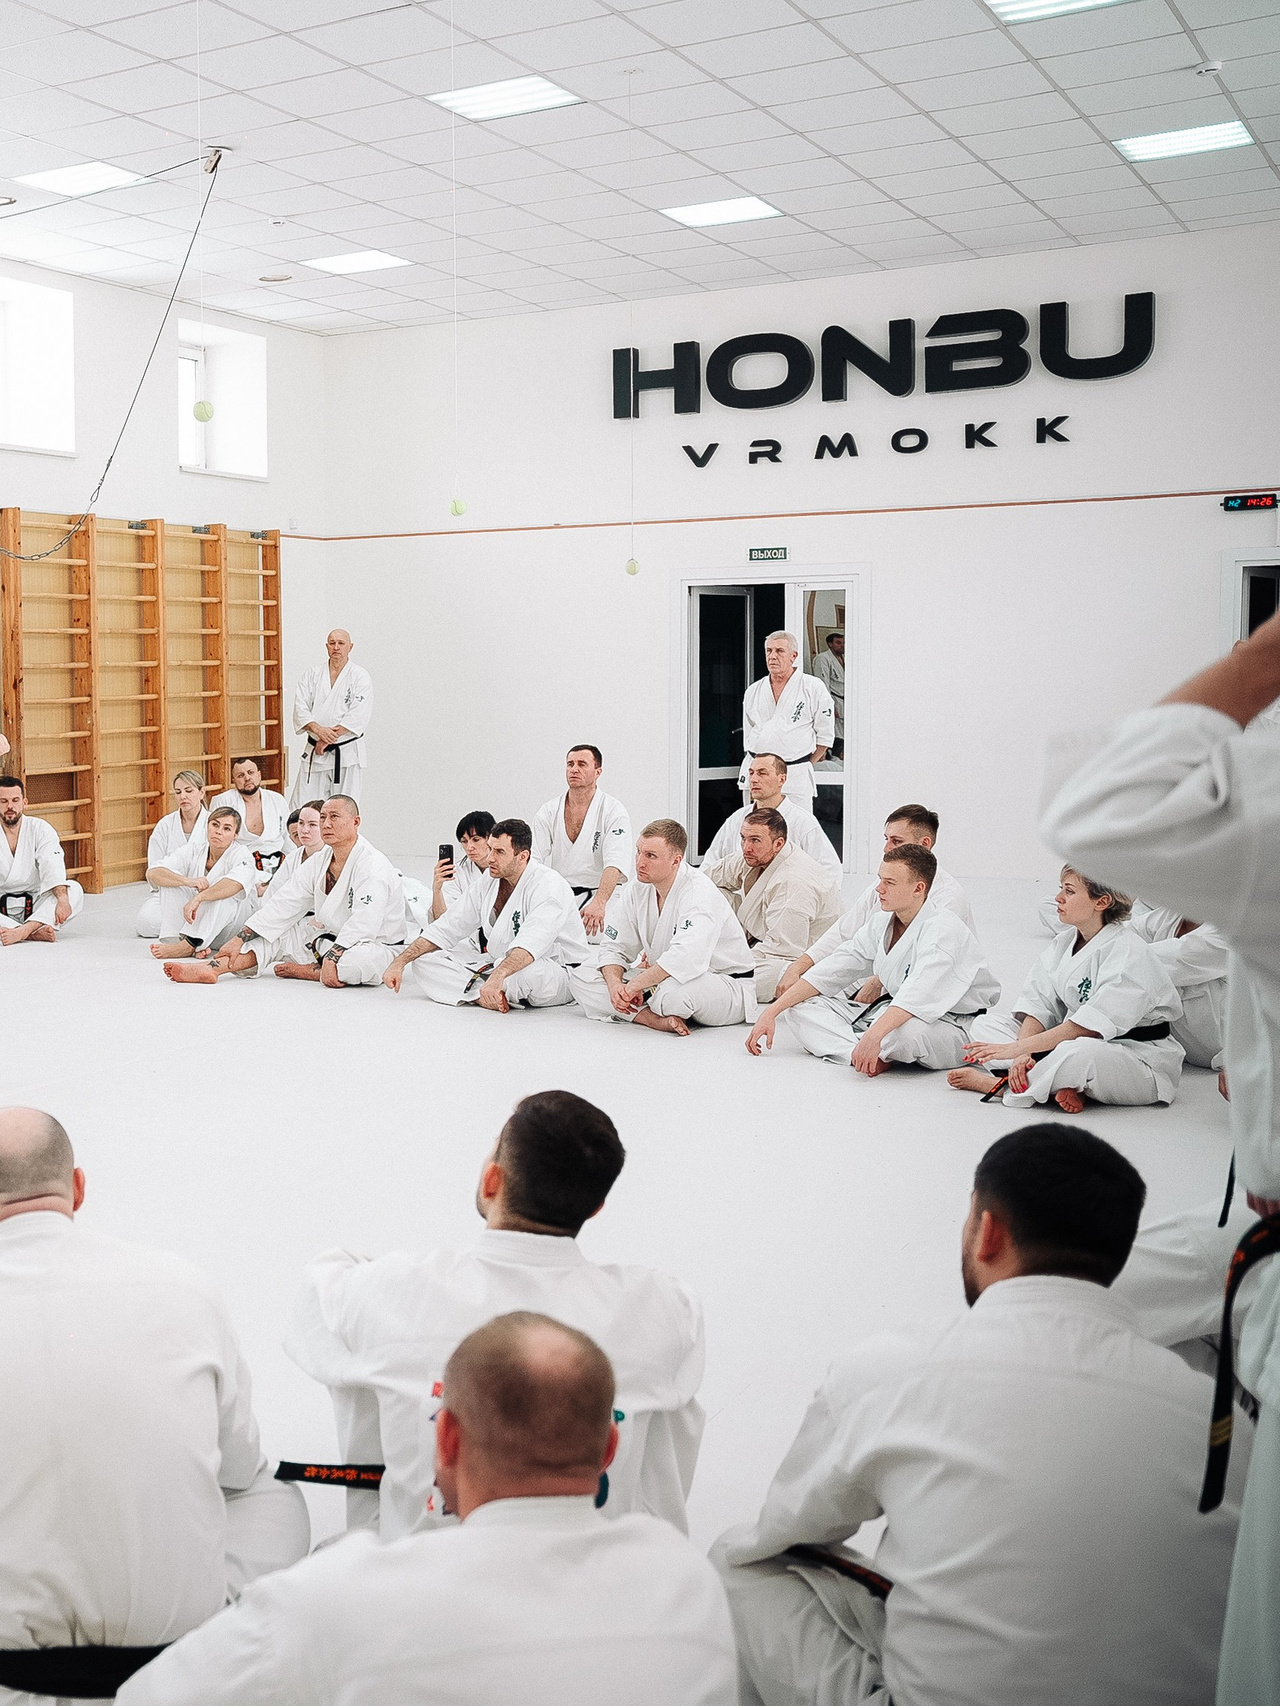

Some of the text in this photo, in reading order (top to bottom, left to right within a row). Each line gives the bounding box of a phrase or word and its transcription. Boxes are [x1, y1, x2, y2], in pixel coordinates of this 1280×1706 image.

[612, 290, 1156, 420] HONBU
[681, 415, 1071, 469] VRMOKK
[1247, 497, 1273, 506] 14:26
[752, 549, 785, 559] ВЫХОД
